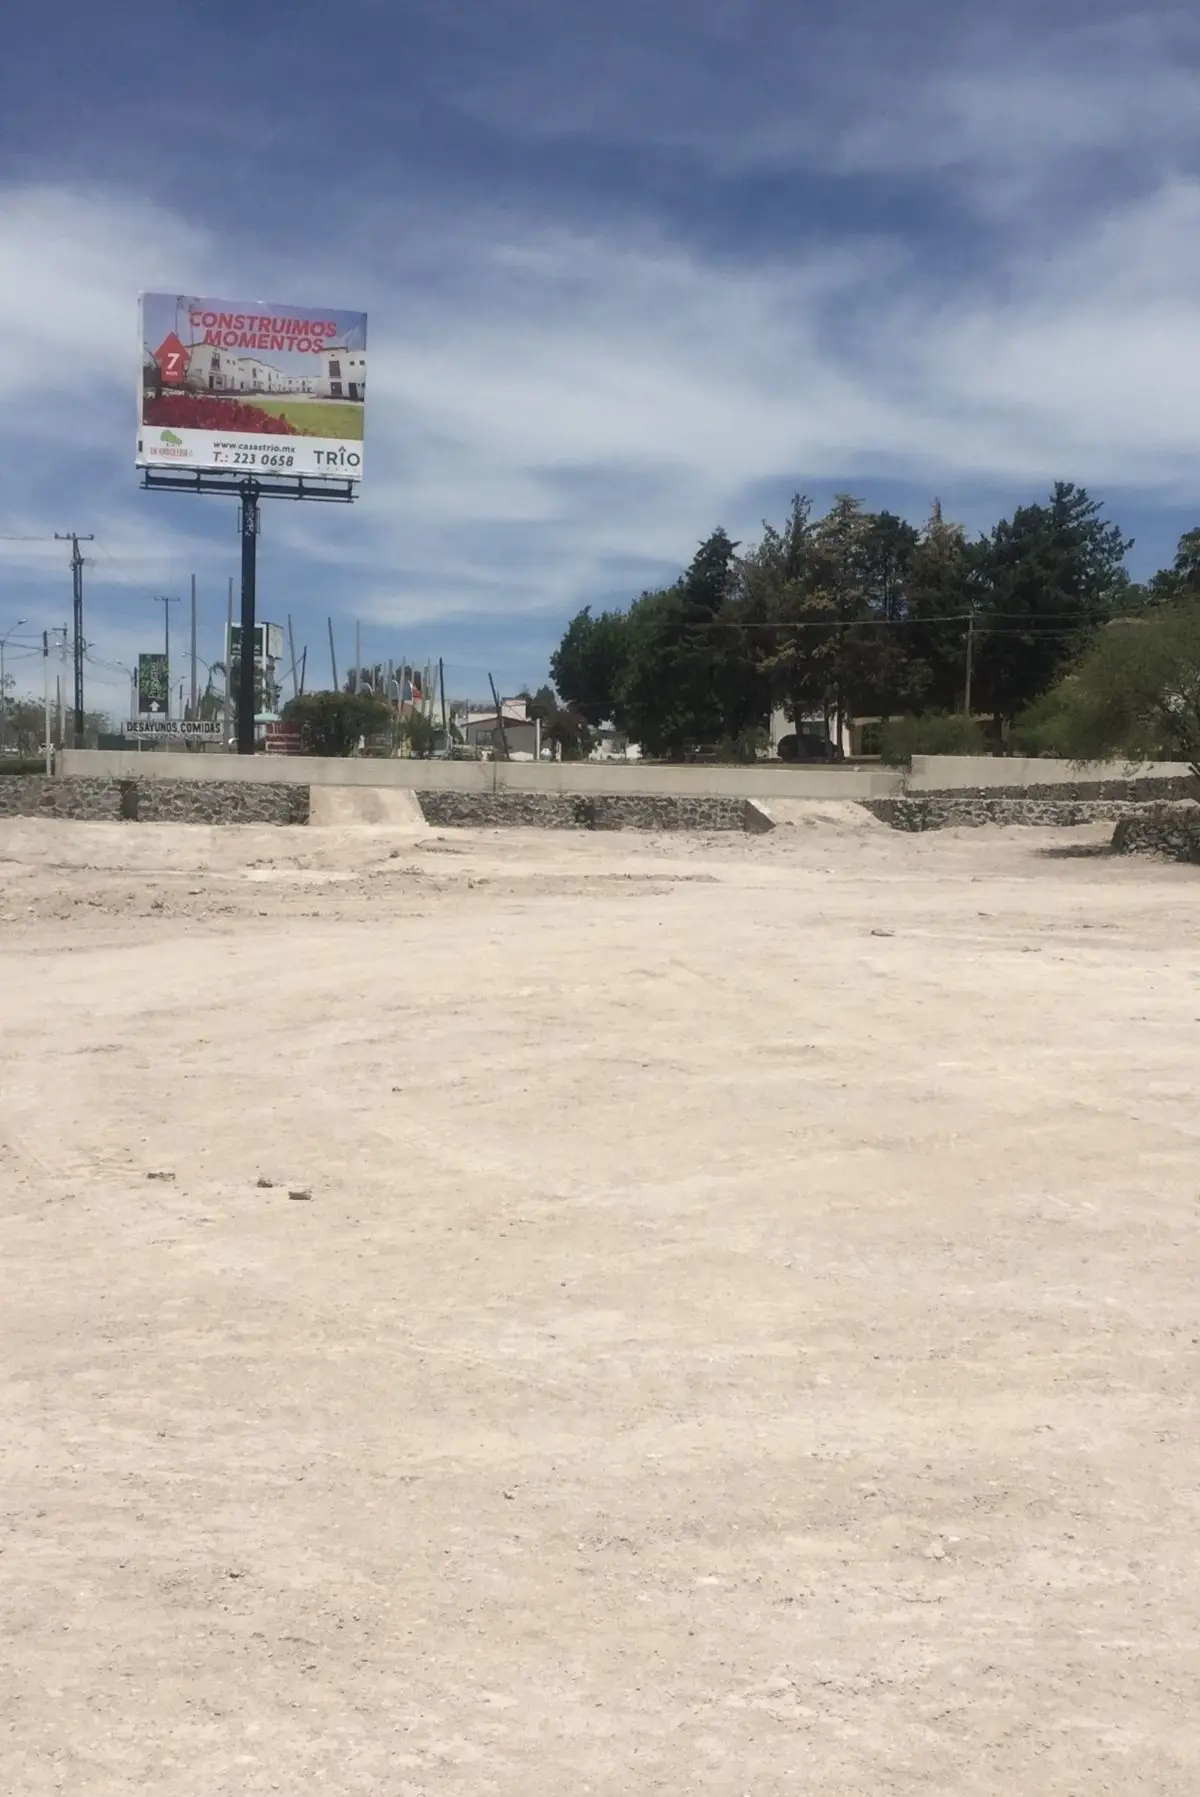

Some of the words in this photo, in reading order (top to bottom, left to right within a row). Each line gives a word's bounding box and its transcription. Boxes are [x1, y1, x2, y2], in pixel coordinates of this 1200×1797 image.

[189, 310, 337, 338] CONSTRUIMOS
[202, 329, 324, 354] MOMENTOS
[167, 352, 180, 370] 7
[213, 442, 296, 453] www.casastrio.mx
[233, 452, 256, 464] 223
[261, 454, 294, 467] 0658
[180, 722, 221, 733] COMIDAS
